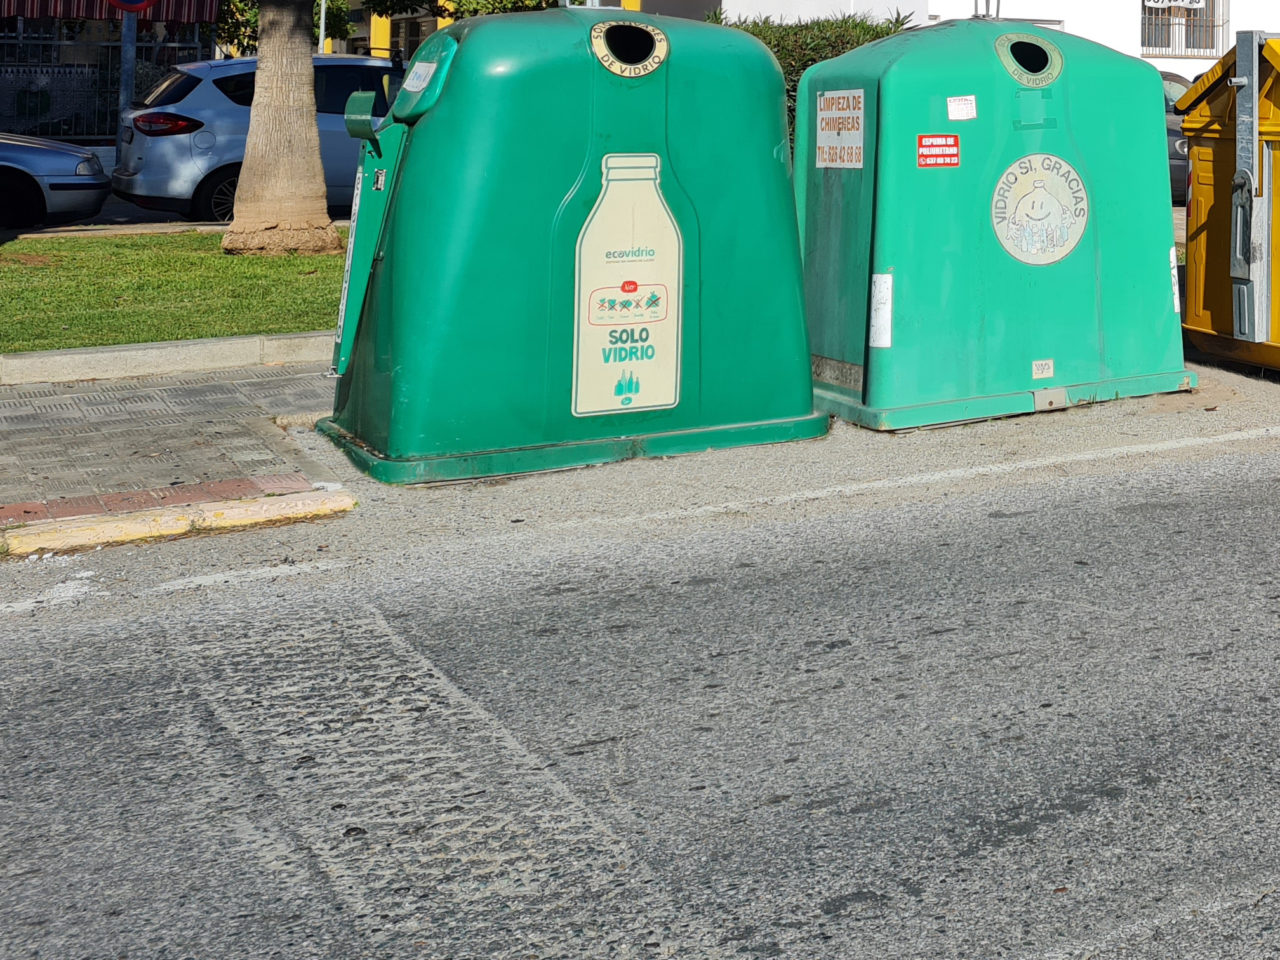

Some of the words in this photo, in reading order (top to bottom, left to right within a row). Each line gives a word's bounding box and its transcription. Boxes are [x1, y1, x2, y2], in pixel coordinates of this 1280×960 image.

[600, 53, 616, 69] DE
[619, 55, 662, 76] VIDRIO
[1026, 72, 1054, 86] VIDRIO
[819, 95, 851, 112] LIMPIEZA
[852, 95, 862, 111] DE
[820, 116, 860, 132] CHIMENEAS
[993, 171, 1018, 225] VIDRIO
[1041, 156, 1086, 219] GRACIAS
[605, 246, 656, 260] ecovidrio
[608, 327, 650, 346] SOLO
[601, 344, 656, 364] VIDRIO
